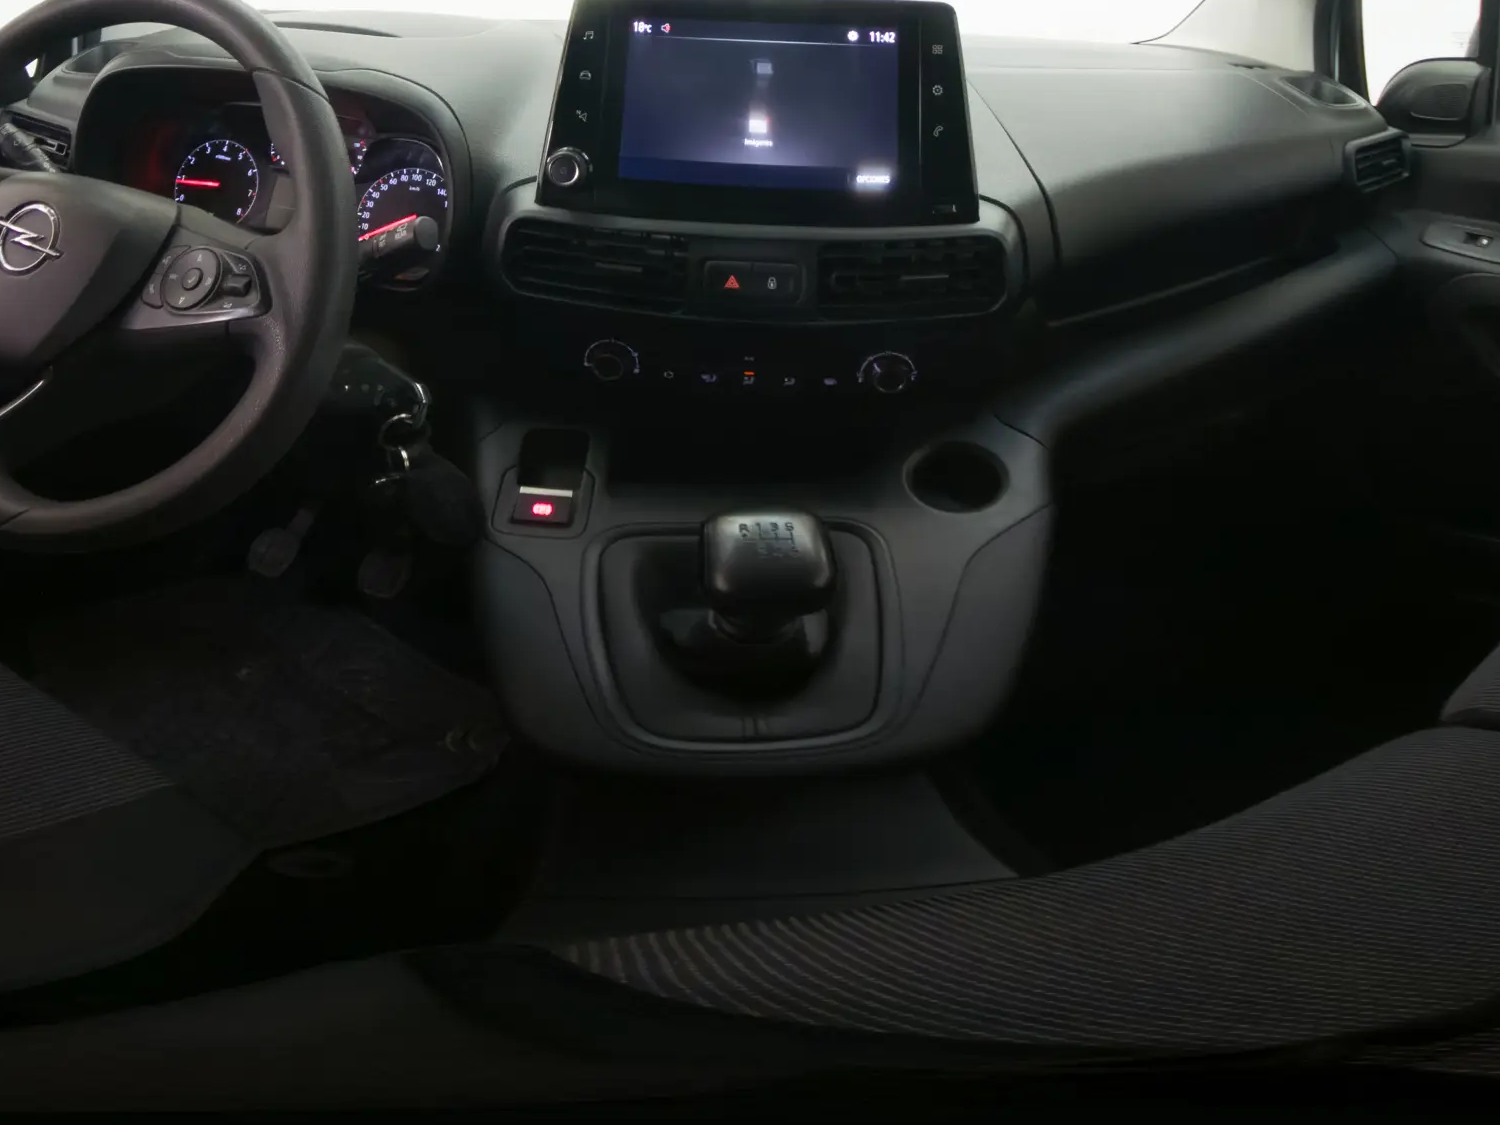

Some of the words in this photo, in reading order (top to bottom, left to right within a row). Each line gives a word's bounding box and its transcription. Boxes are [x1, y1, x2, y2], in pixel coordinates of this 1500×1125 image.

[869, 31, 896, 43] 11:42
[400, 174, 409, 182] 80
[411, 174, 422, 182] 100
[380, 183, 389, 191] 50
[426, 179, 436, 187] 120
[371, 191, 380, 199] 40
[365, 200, 374, 208] 30
[361, 211, 370, 219] 20
[739, 523, 750, 533] R
[770, 522, 779, 532] 3
